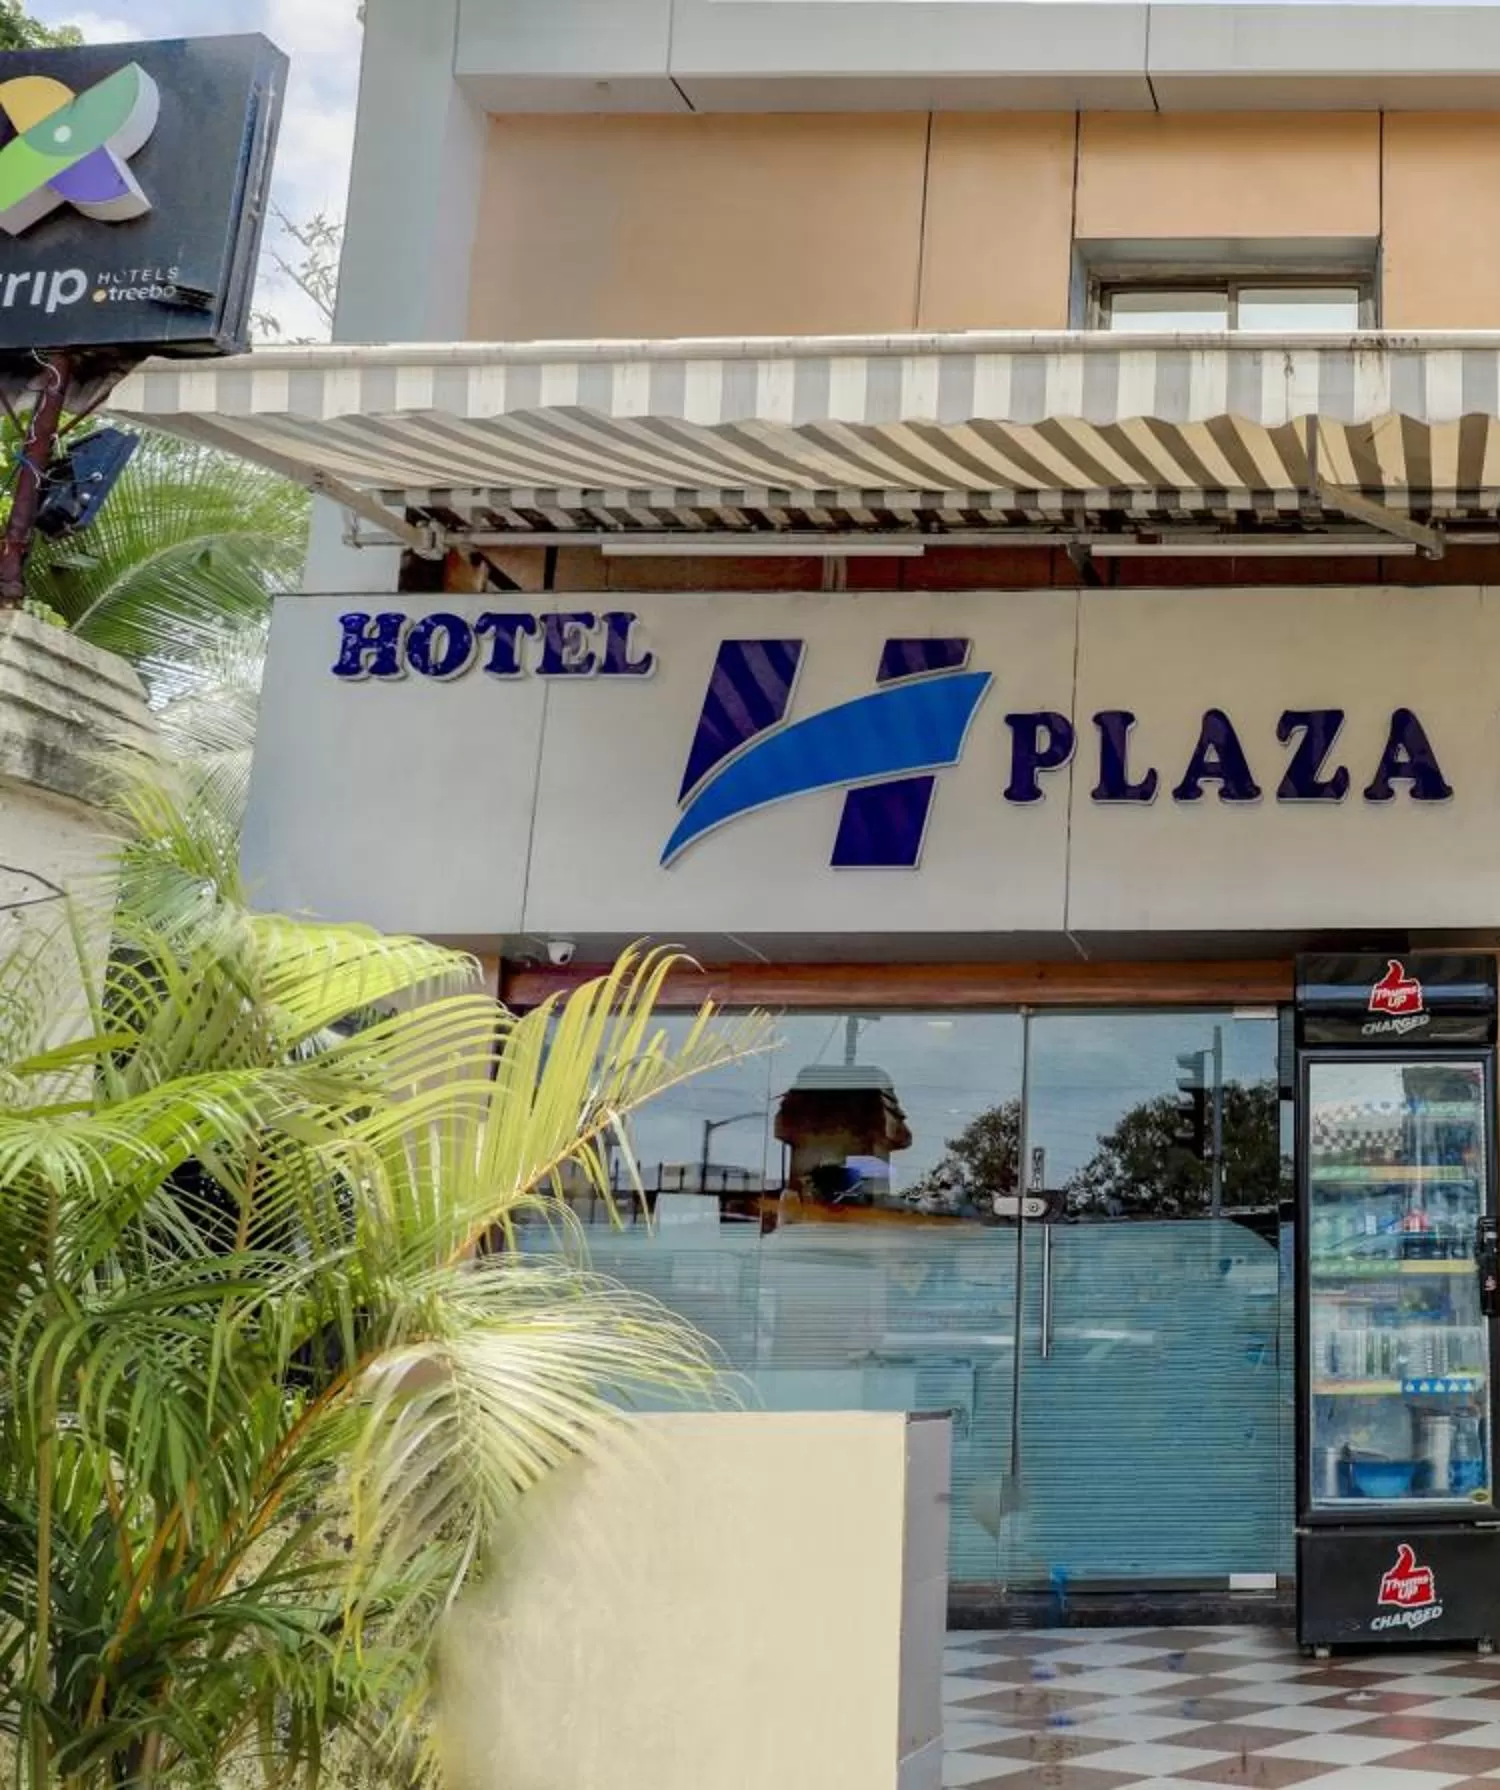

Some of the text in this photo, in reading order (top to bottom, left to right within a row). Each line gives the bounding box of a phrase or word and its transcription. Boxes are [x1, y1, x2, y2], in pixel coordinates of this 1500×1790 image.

[0, 268, 87, 313] rip
[333, 612, 656, 681] HOTEL
[1003, 706, 1455, 803] PLAZA
[1361, 1014, 1431, 1035] CHARGED
[1370, 1605, 1443, 1630] CHARGED
